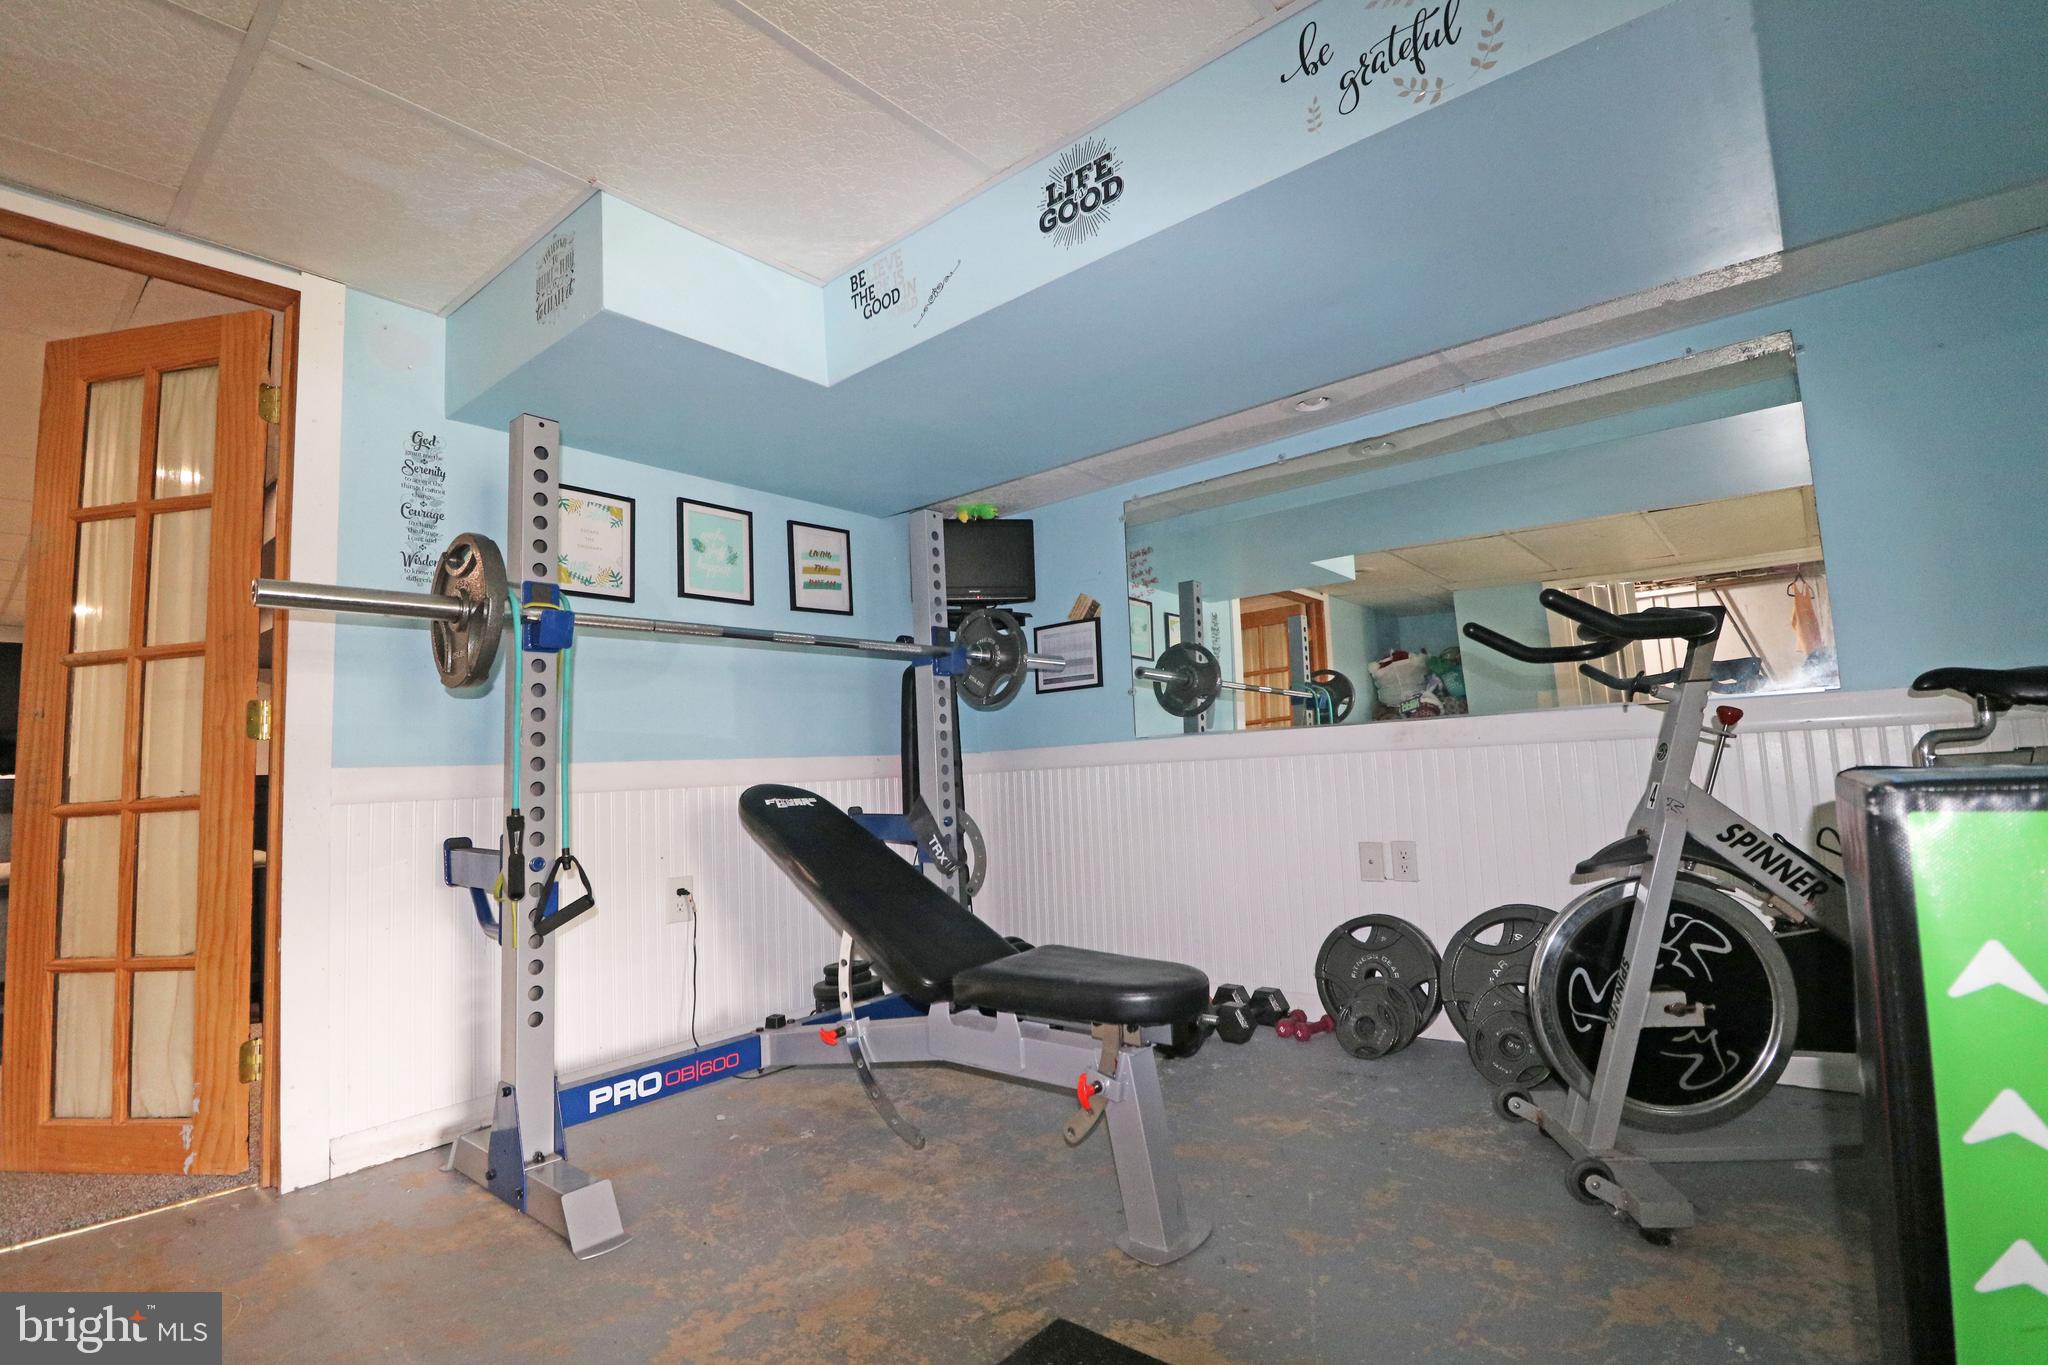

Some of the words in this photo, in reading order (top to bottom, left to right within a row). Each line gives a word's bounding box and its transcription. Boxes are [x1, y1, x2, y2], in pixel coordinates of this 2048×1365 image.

[1280, 21, 1334, 84] be
[1338, 0, 1462, 115] grateful
[1039, 175, 1124, 233] GOOD
[1046, 152, 1113, 208] LIFE
[863, 288, 901, 320] GOOD
[412, 430, 436, 451] God
[401, 458, 446, 482] Serenity
[400, 502, 446, 524] Courage
[928, 833, 948, 865] TRX
[1715, 823, 1830, 902] SPINNER
[1607, 956, 1630, 1030] SPINNER
[589, 1071, 663, 1114] PRO
